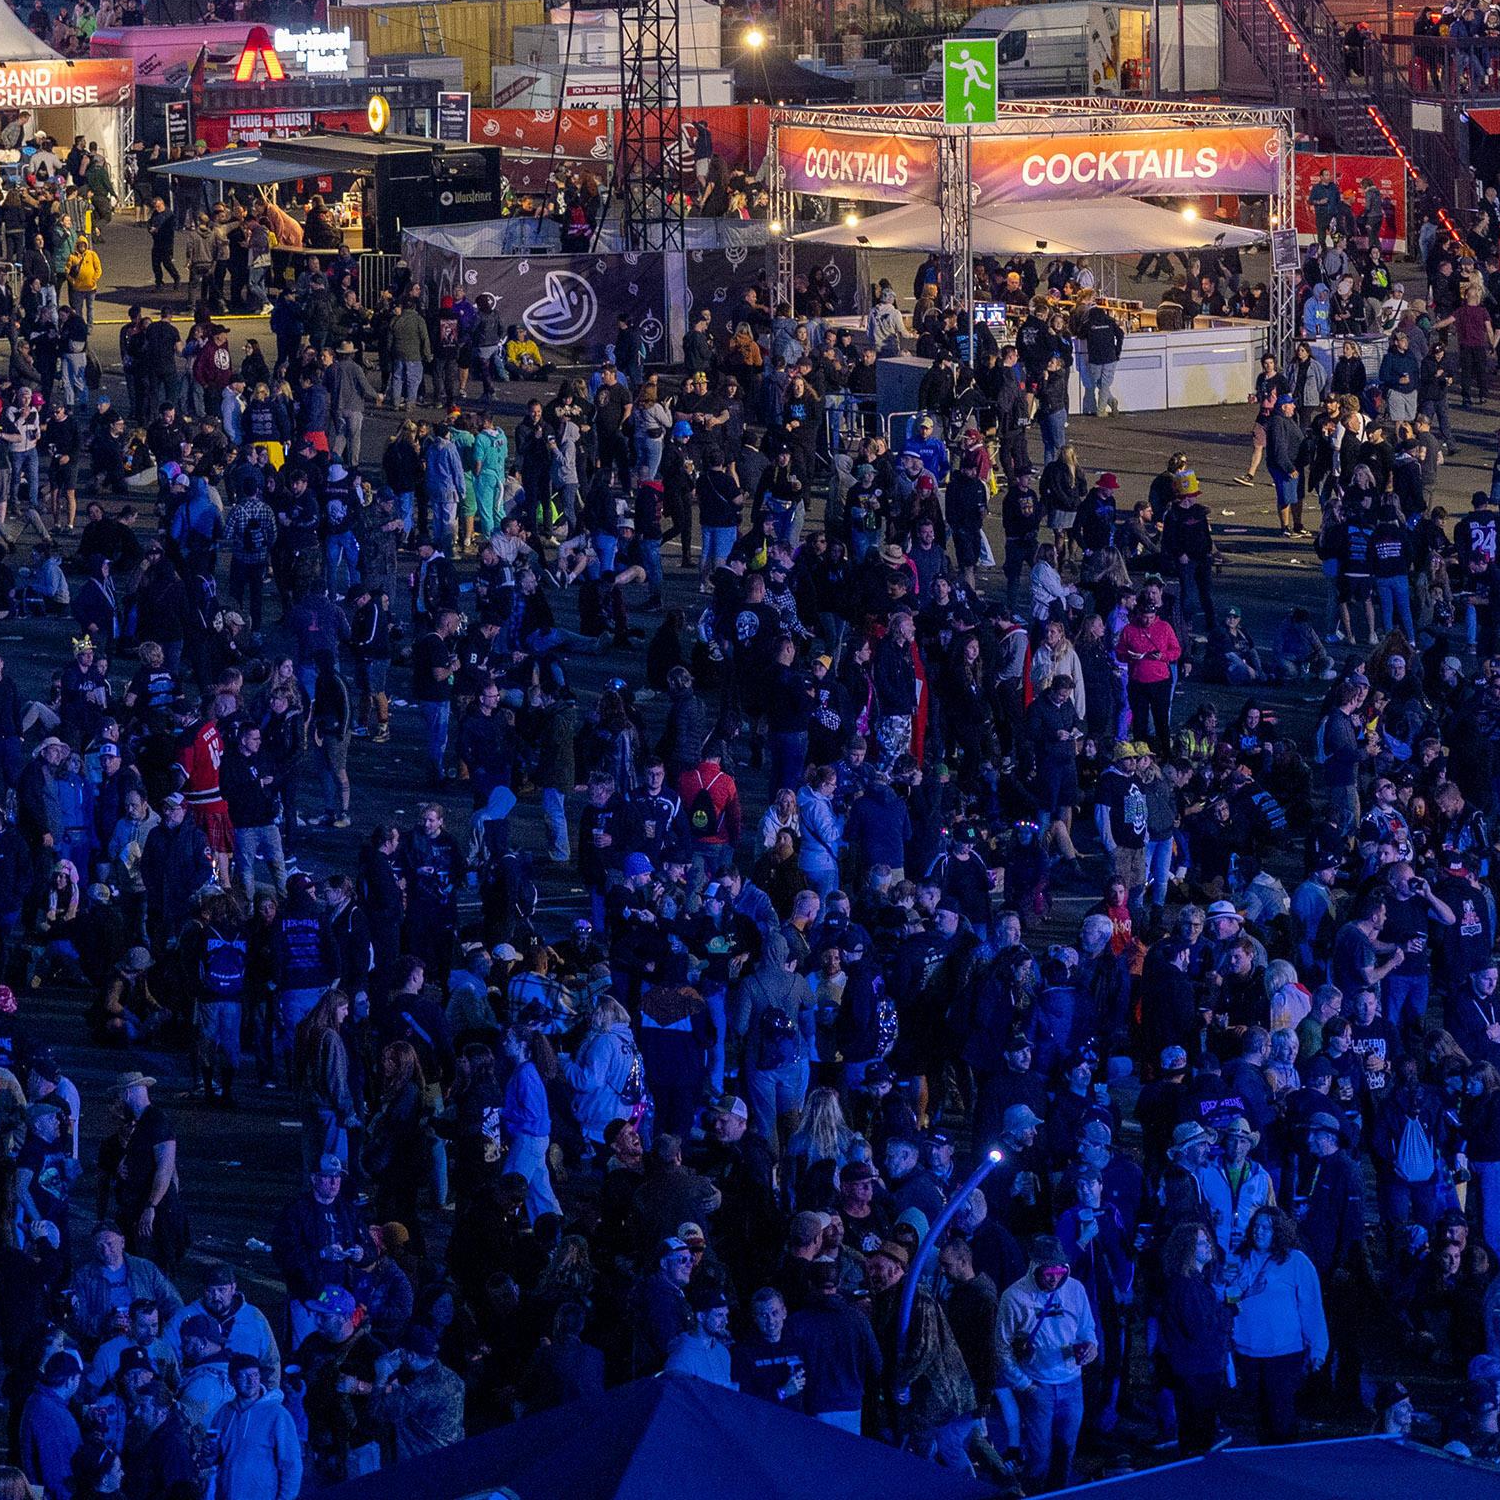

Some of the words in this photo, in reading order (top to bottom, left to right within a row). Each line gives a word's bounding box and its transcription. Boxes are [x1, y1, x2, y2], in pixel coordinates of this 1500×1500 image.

[805, 146, 908, 186] COCKTAILS
[1022, 148, 1218, 188] COCKTAILS
[455, 190, 492, 205] Warsteiner
